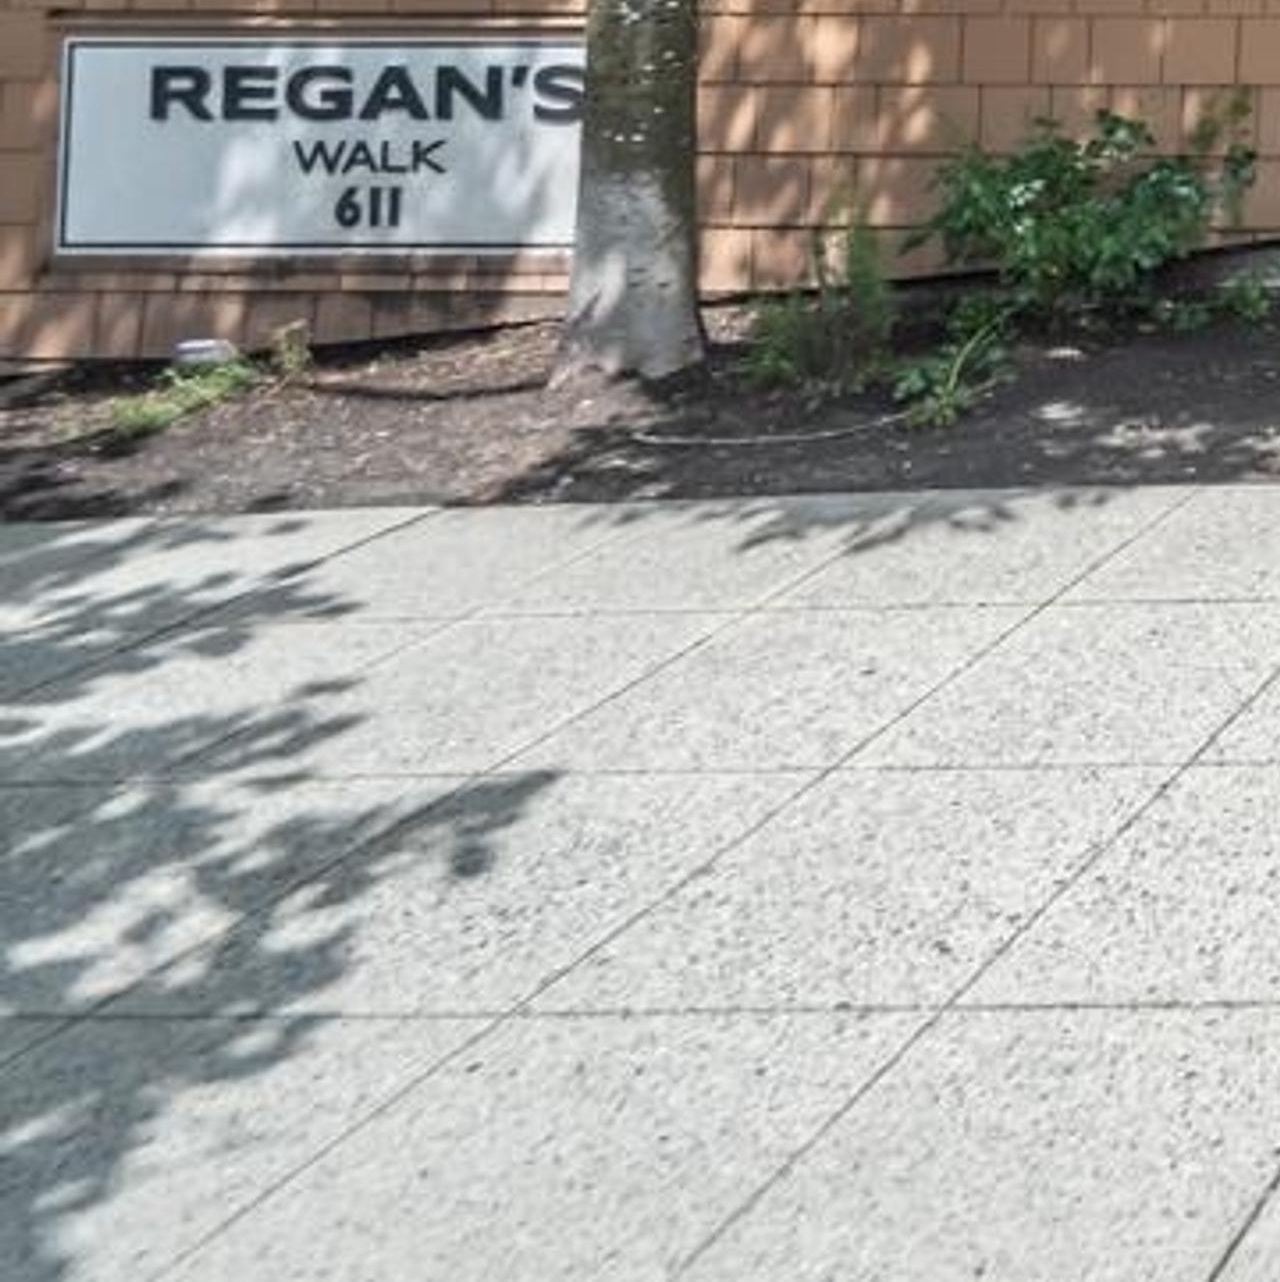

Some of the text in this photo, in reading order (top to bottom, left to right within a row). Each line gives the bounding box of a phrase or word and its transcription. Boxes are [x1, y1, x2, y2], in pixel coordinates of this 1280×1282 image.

[150, 65, 584, 124] REGAN'S
[294, 140, 446, 175] WALK
[334, 186, 402, 229] 611
